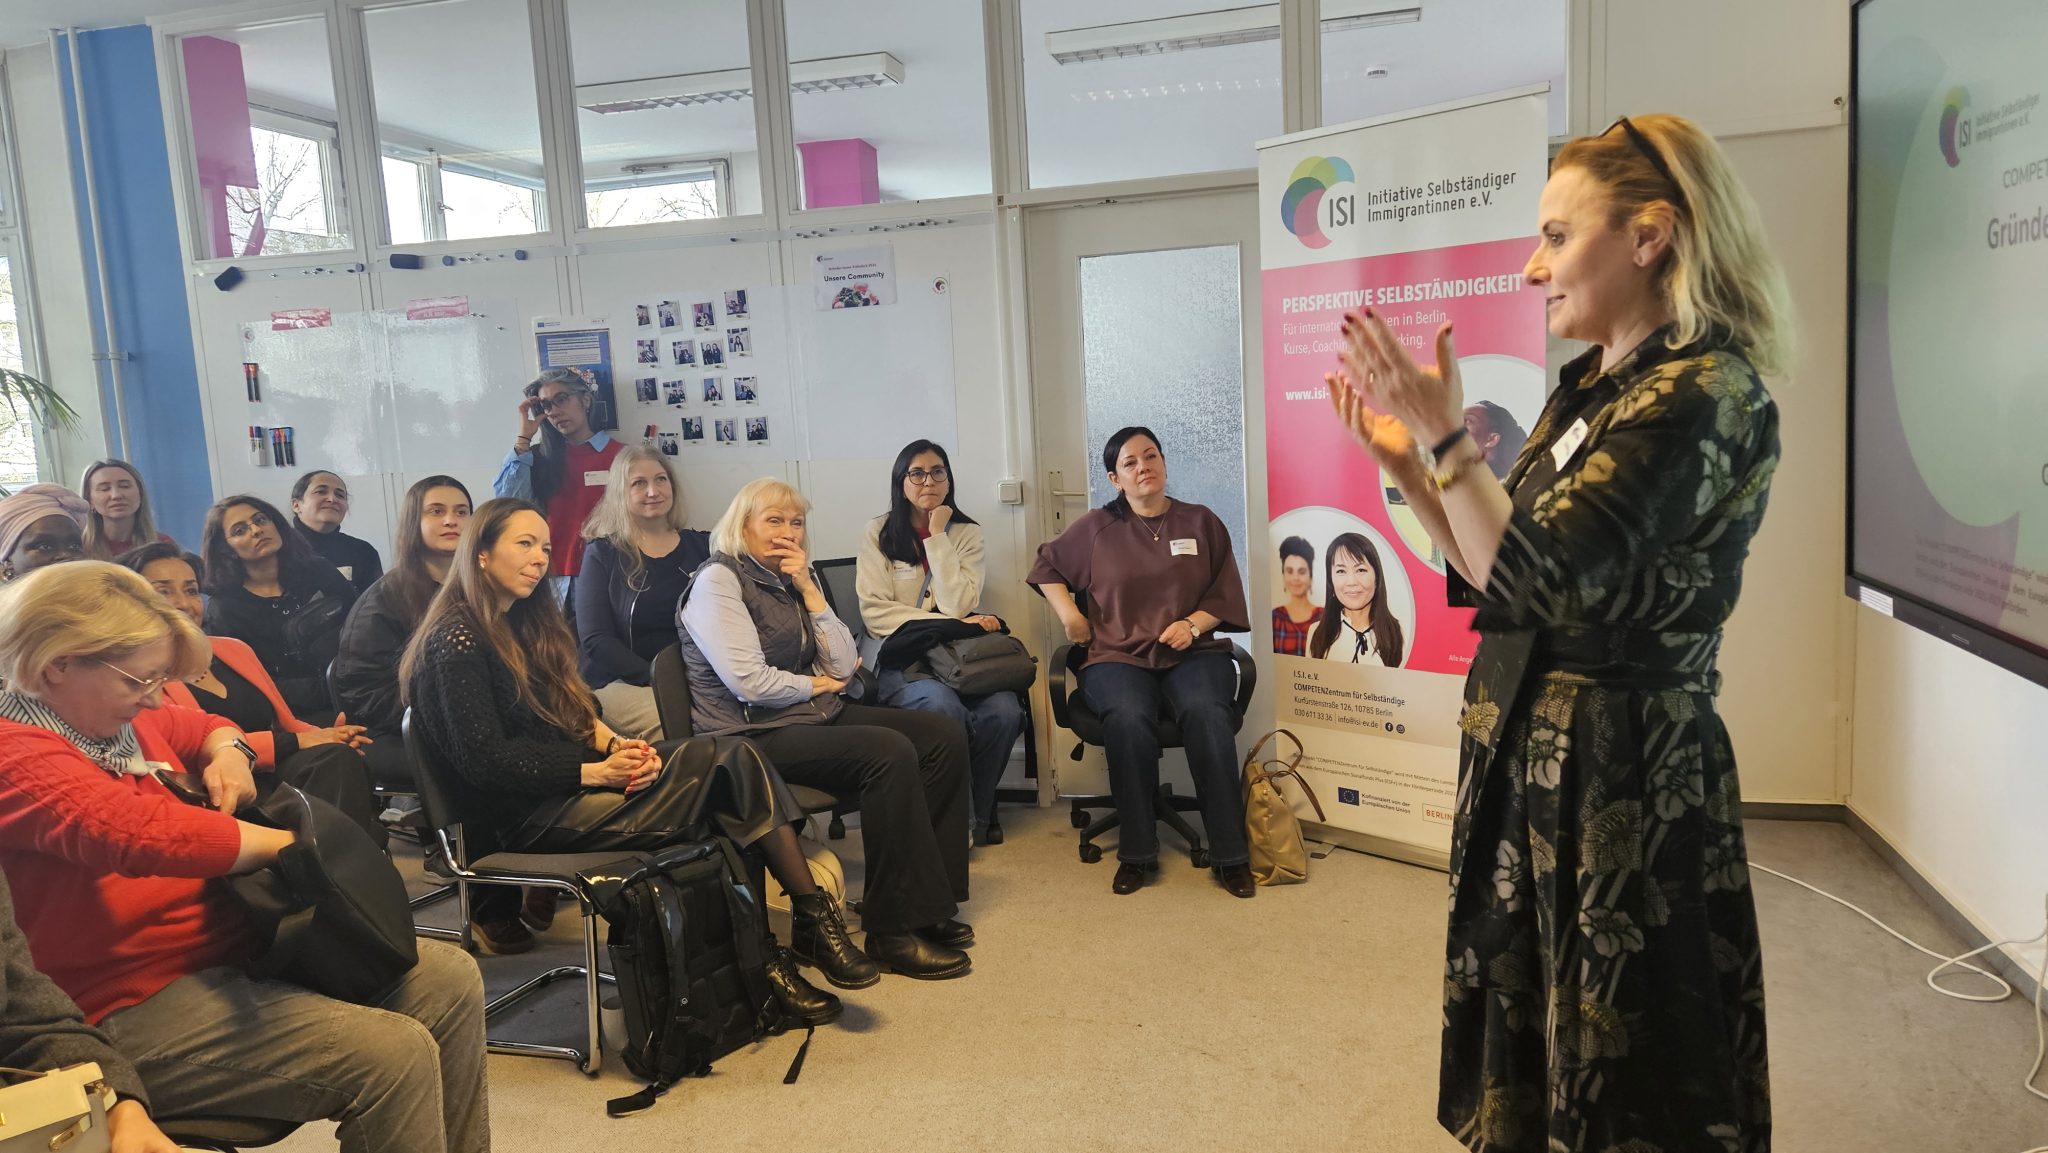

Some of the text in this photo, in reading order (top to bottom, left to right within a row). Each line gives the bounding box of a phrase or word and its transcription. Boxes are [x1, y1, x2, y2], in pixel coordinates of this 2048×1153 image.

[1959, 119, 1971, 149] ISI
[1368, 171, 1517, 206] Initiative Selbständiger
[1329, 194, 1355, 228] ISI
[1368, 190, 1493, 223] Immigrantinnen e.V.
[847, 271, 885, 280] Community
[1282, 272, 1523, 314] PERSPEKTIVE SELBSTÄNDIGKEIT
[1283, 323, 1298, 336] Für
[1402, 312, 1413, 326] in
[1284, 342, 1311, 355] Kurse,
[1294, 682, 1406, 708] COMPETENZentrum für Selbständige
[1294, 696, 1393, 718] Kurfürstenstraße 126, 10785 Berlin
[1426, 809, 1453, 821] BERLIN
